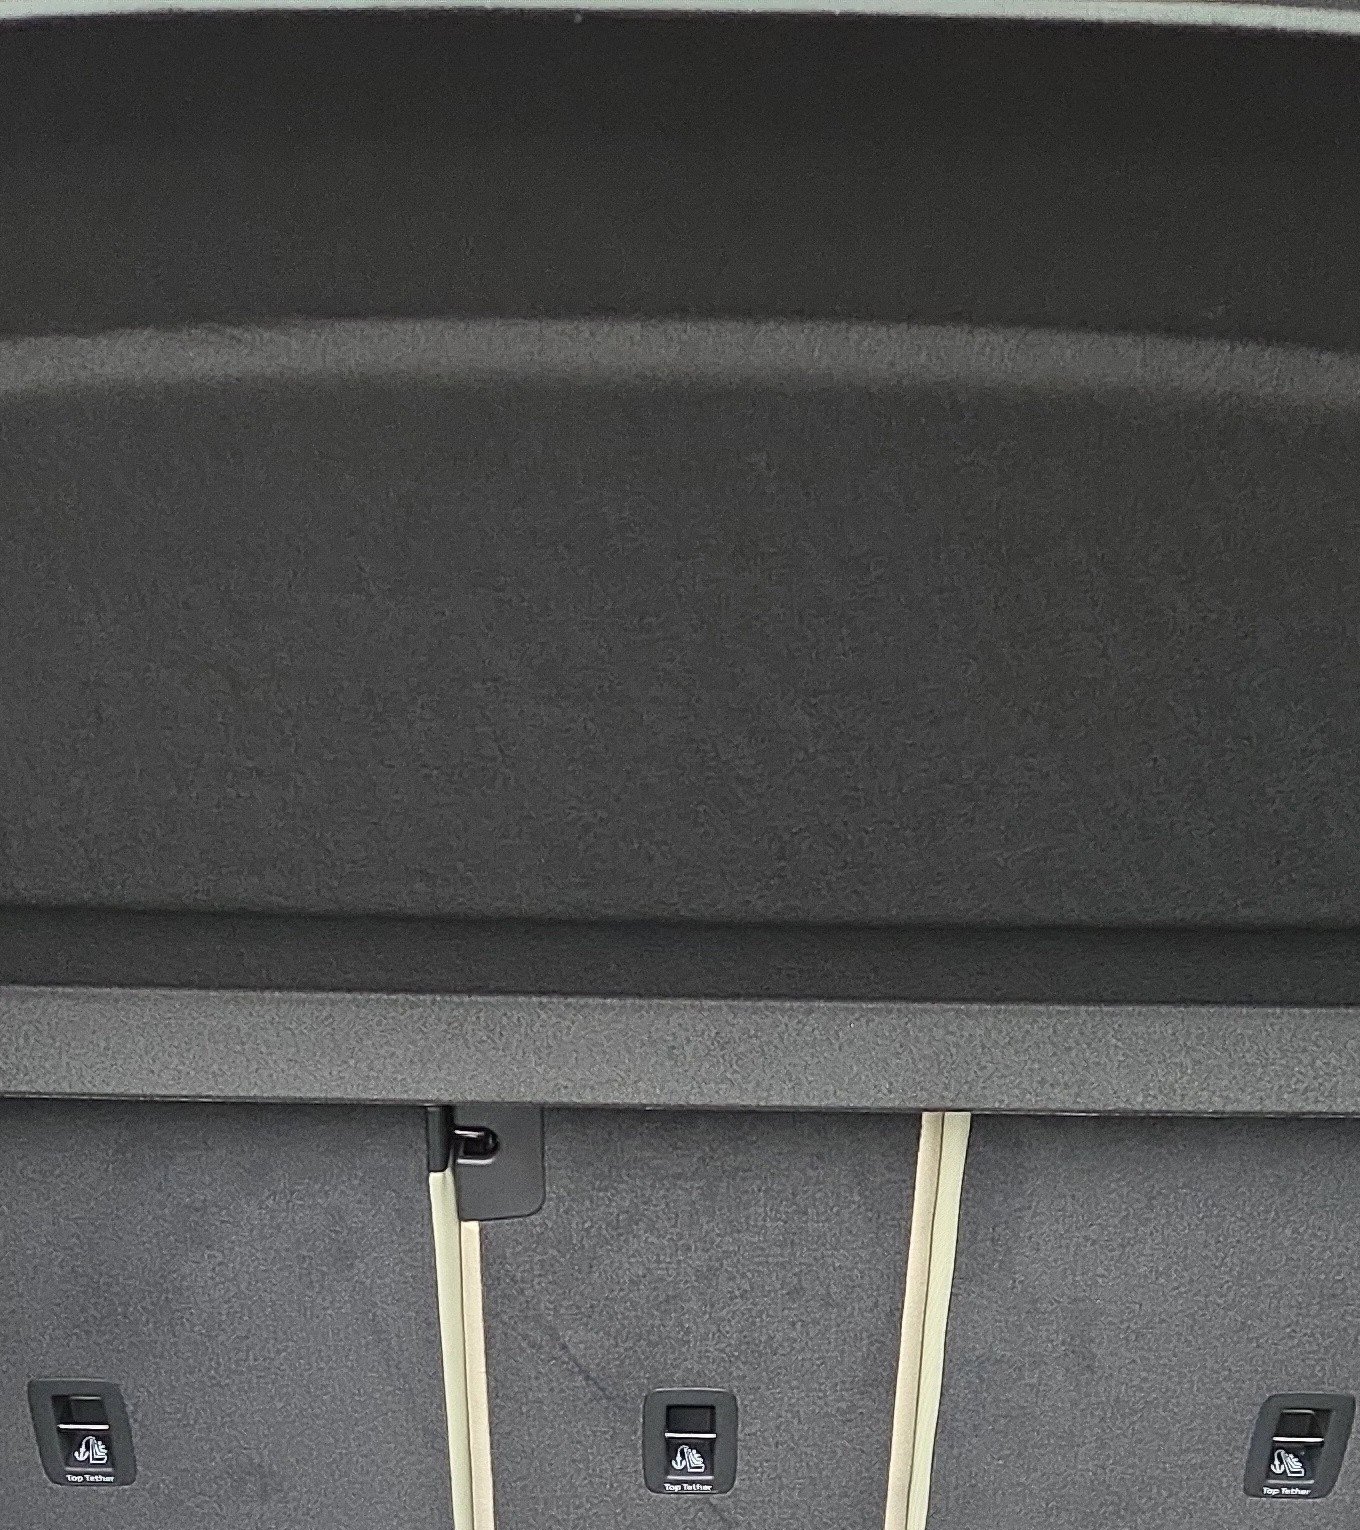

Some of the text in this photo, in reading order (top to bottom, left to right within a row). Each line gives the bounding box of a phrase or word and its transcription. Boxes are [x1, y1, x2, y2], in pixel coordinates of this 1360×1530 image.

[66, 1474, 83, 1482] Top
[663, 1483, 681, 1492] Top
[1262, 1486, 1280, 1495] Top
